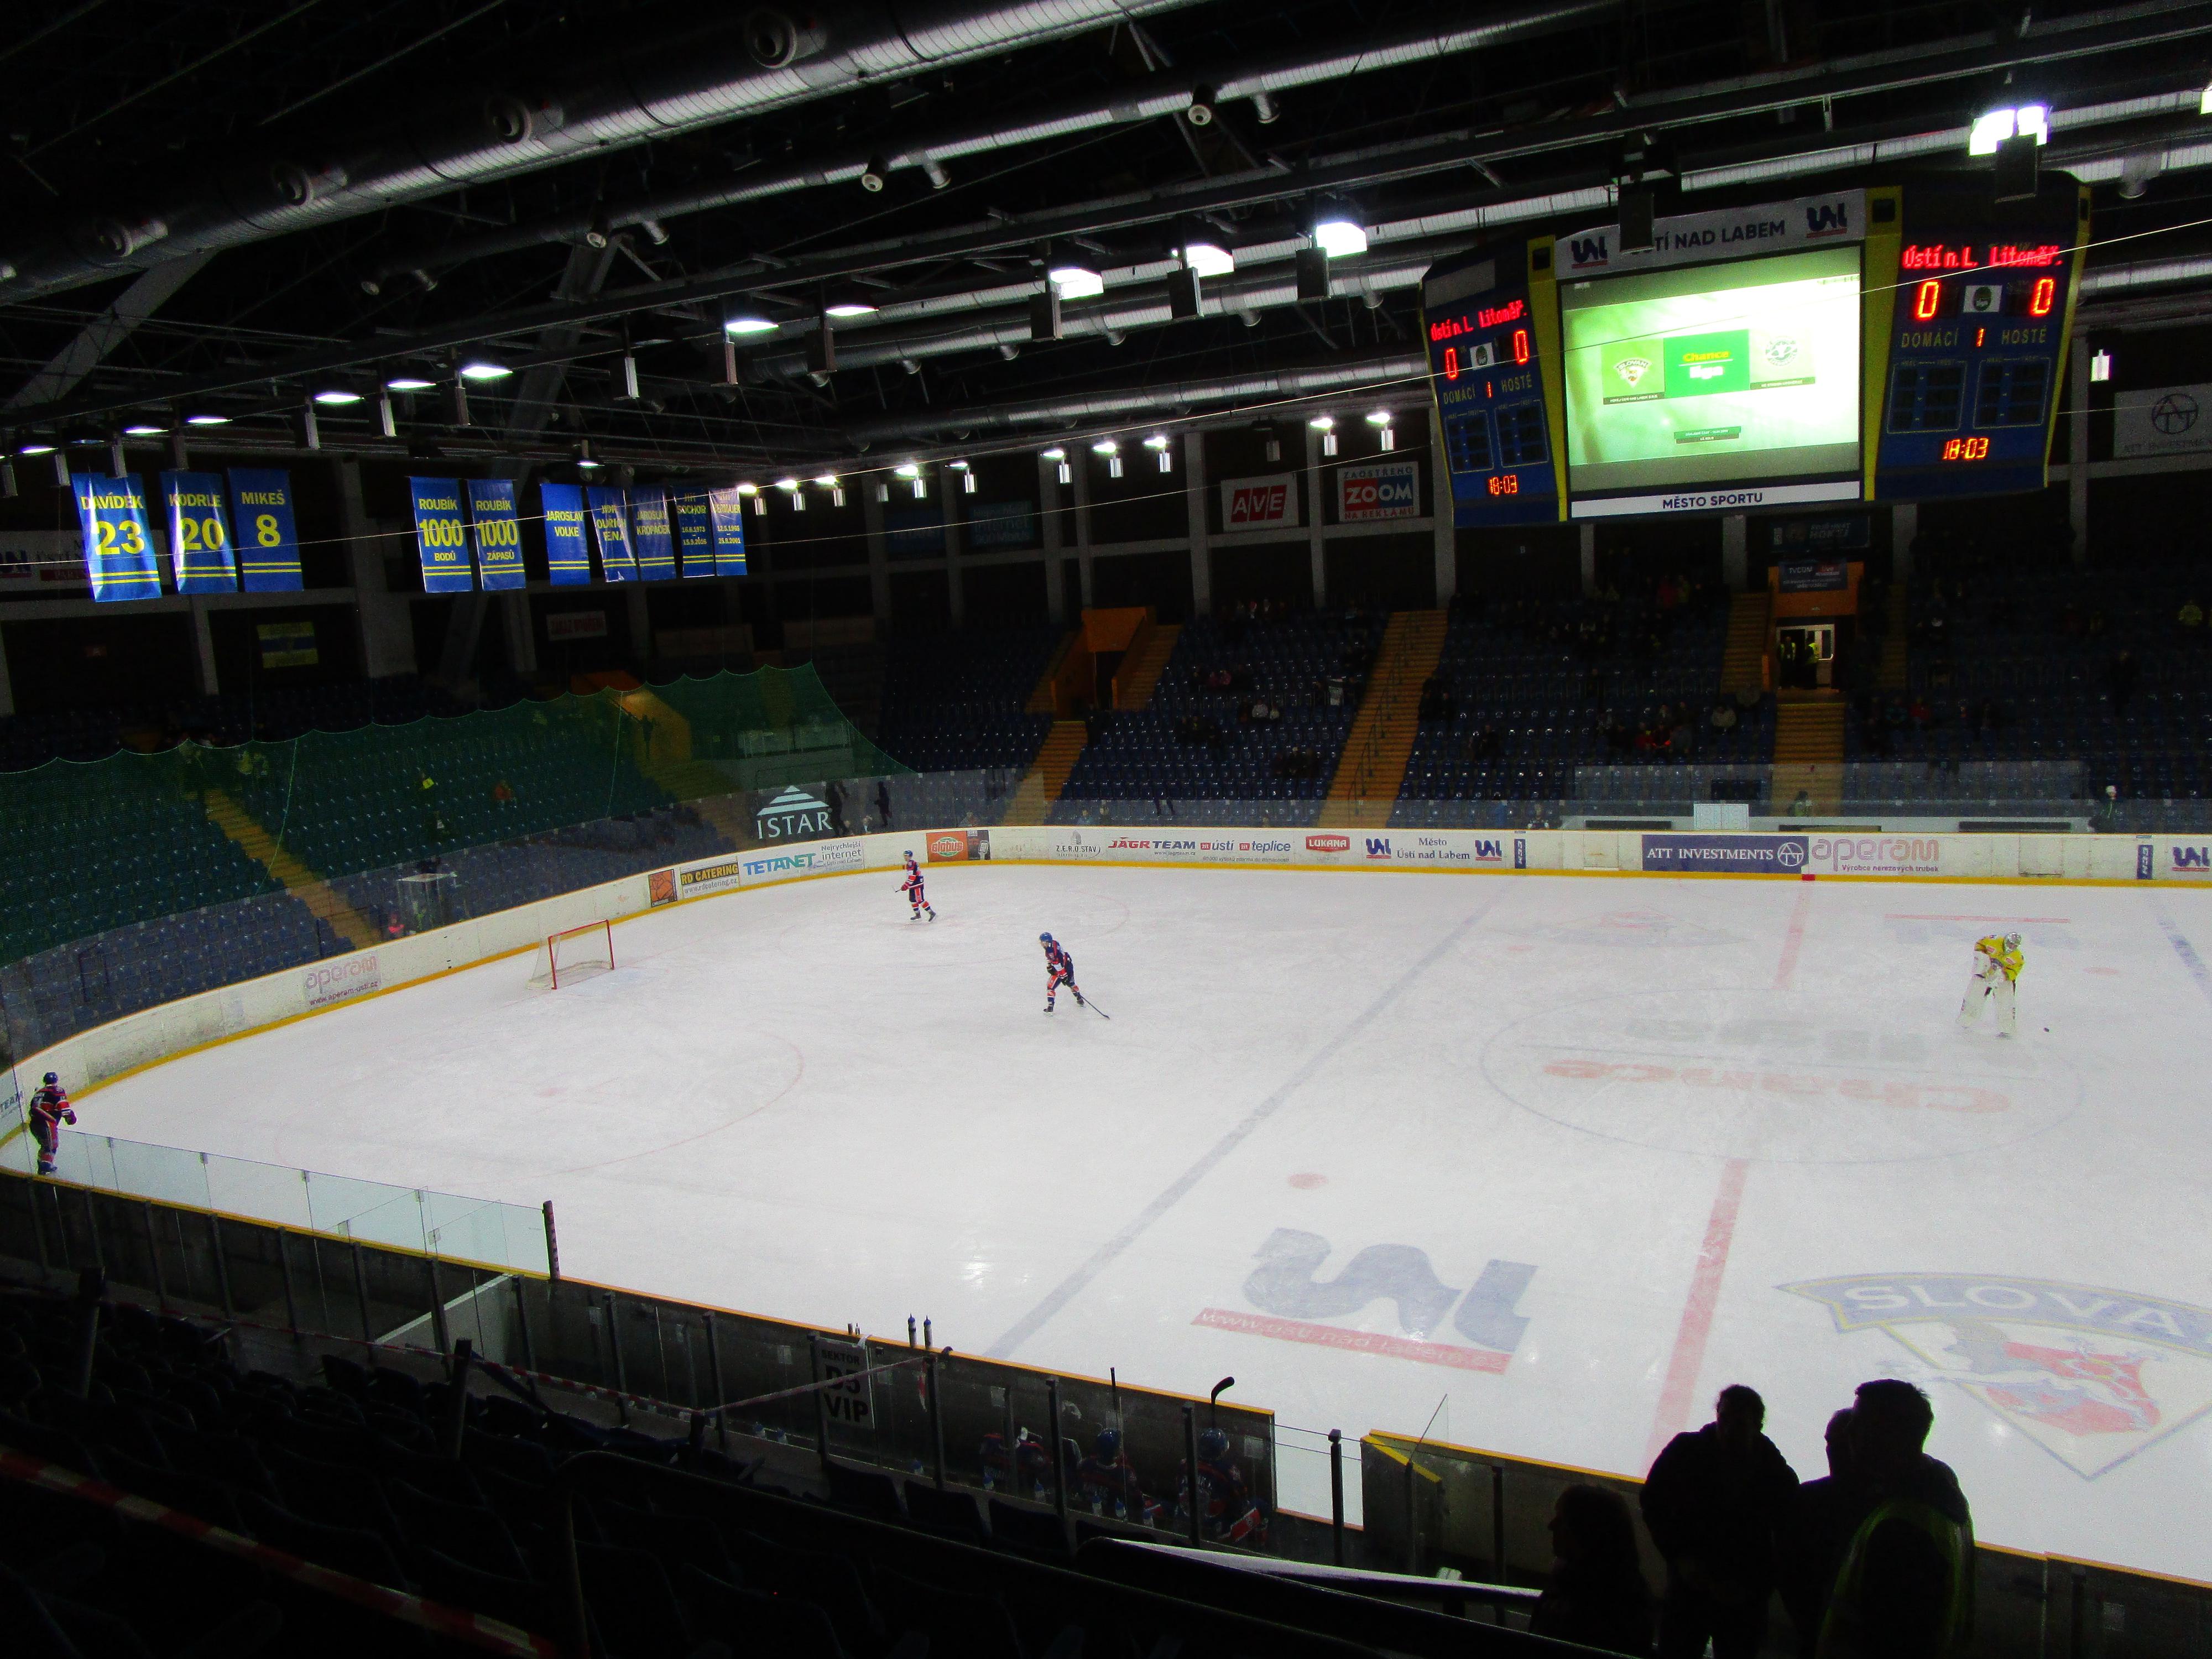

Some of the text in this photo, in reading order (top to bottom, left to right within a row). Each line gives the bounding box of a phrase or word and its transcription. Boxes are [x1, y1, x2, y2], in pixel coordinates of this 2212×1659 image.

[1676, 230, 1715, 249] NAD
[1721, 220, 1785, 242] LABEM
[1916, 280, 1940, 320] 0
[2031, 278, 2055, 316] 0
[1901, 327, 1959, 348] DOMÁCÍ
[2002, 325, 2047, 345] HOSTÉ
[1514, 329, 1529, 364] 0
[1444, 347, 1459, 380] 0
[1682, 349, 1730, 362] Chance
[1618, 359, 1649, 371] SLOVAN
[1690, 363, 1724, 379] liga
[1501, 372, 1532, 393] HOSTÉ
[1443, 384, 1475, 404] DOMÁCÍ
[1942, 437, 1990, 460] 18:03
[80, 492, 143, 510] DAVÍDEK
[169, 492, 222, 507] KODRLE
[241, 489, 285, 505] MIKEŠ
[1347, 482, 1412, 504] ZOOM
[1662, 492, 1763, 509] MĚSTO SPORTU
[419, 496, 458, 510] ROUBÍK
[476, 498, 512, 510] ROUBÍK
[677, 505, 707, 514] SOCHOR
[1233, 492, 1284, 515] AVE
[546, 510, 583, 521] JAROSLAV
[92, 520, 145, 555] 23
[181, 517, 224, 551] 20
[256, 514, 280, 547] 8
[419, 519, 463, 547] 1000
[477, 519, 518, 547] 1000
[554, 526, 579, 537] VOLKE
[637, 523, 670, 535] KROPÁČEK
[435, 550, 456, 561] BODŮ
[487, 549, 514, 561] ZÁPASŮ
[757, 811, 833, 839] ISTAR
[821, 841, 861, 852] Nejrychlejší
[1152, 841, 1196, 849] TEAM
[1212, 840, 1234, 851] ústí
[1251, 841, 1291, 853] teplice
[1308, 838, 1347, 848] LUKANA
[1419, 837, 1447, 846] Město
[822, 848, 862, 860] internet
[1397, 848, 1470, 859] Ústí nad Labem
[1647, 848, 1673, 858] ATT
[1679, 848, 1774, 860] INVESTMENTS
[1812, 839, 1939, 872] aperam
[743, 853, 816, 875] TETANET
[1842, 863, 1871, 872] Výrobce
[1873, 864, 1913, 873] nerezových
[681, 864, 738, 885] RD CATERING
[684, 878, 737, 894] www.rdcatering.cz
[305, 956, 378, 994] aperam
[1844, 1283, 2212, 1339] SLOVA
[822, 1349, 860, 1364] SEKTOR
[823, 1392, 869, 1422] VIP
